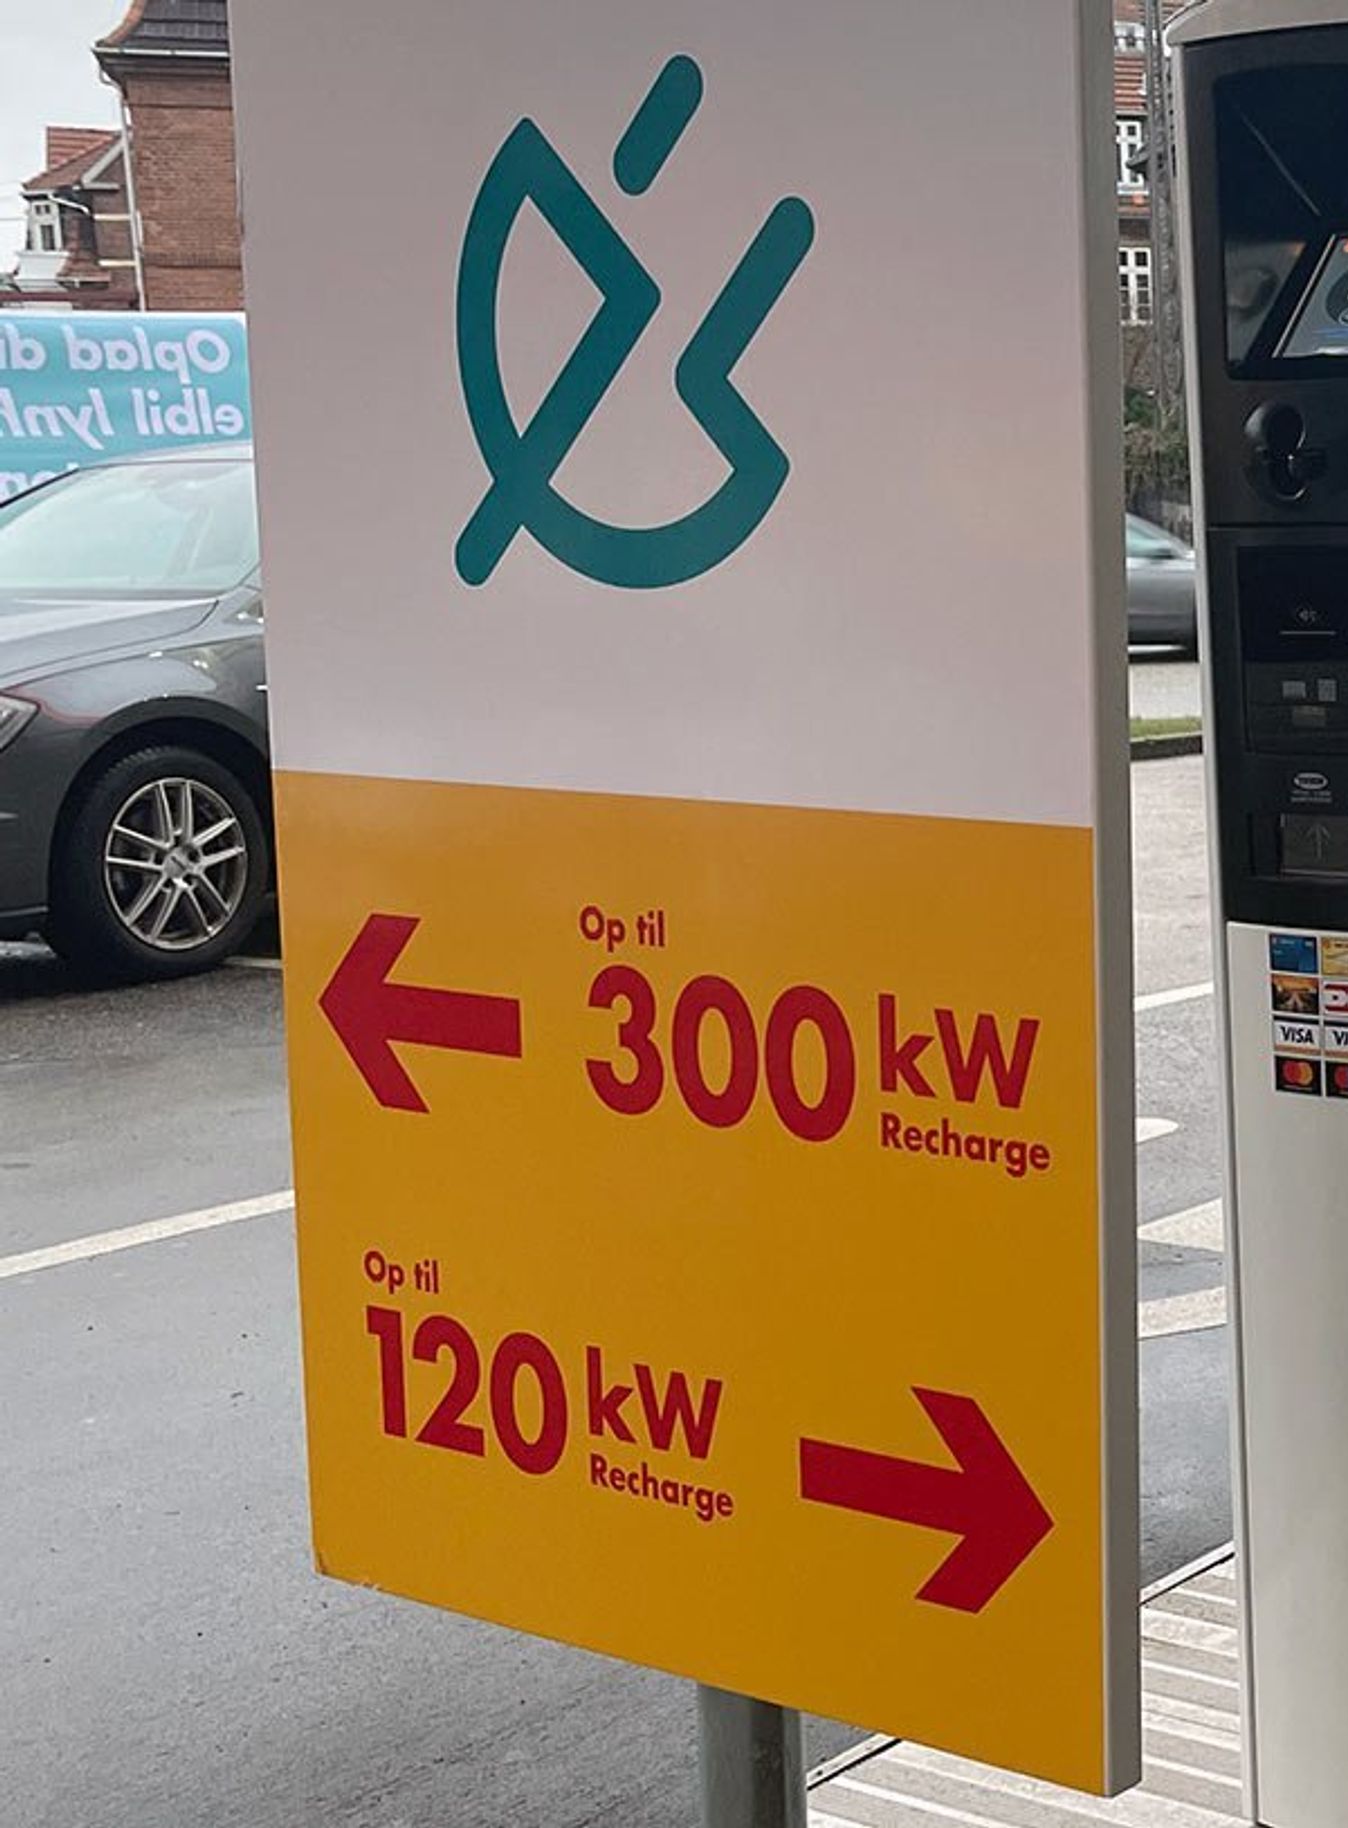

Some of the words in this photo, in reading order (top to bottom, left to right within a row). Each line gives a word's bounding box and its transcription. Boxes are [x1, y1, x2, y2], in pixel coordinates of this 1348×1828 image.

[579, 906, 627, 953] Op
[636, 909, 667, 949] til
[585, 964, 857, 1143] 300
[878, 993, 1041, 1110] kW
[1279, 1025, 1315, 1044] VISA
[879, 1112, 1051, 1179] Recharge
[363, 1250, 405, 1295] Op
[414, 1258, 440, 1294] til
[365, 1304, 569, 1476] 120
[586, 1345, 724, 1460] kW
[590, 1453, 734, 1522] Recharge
